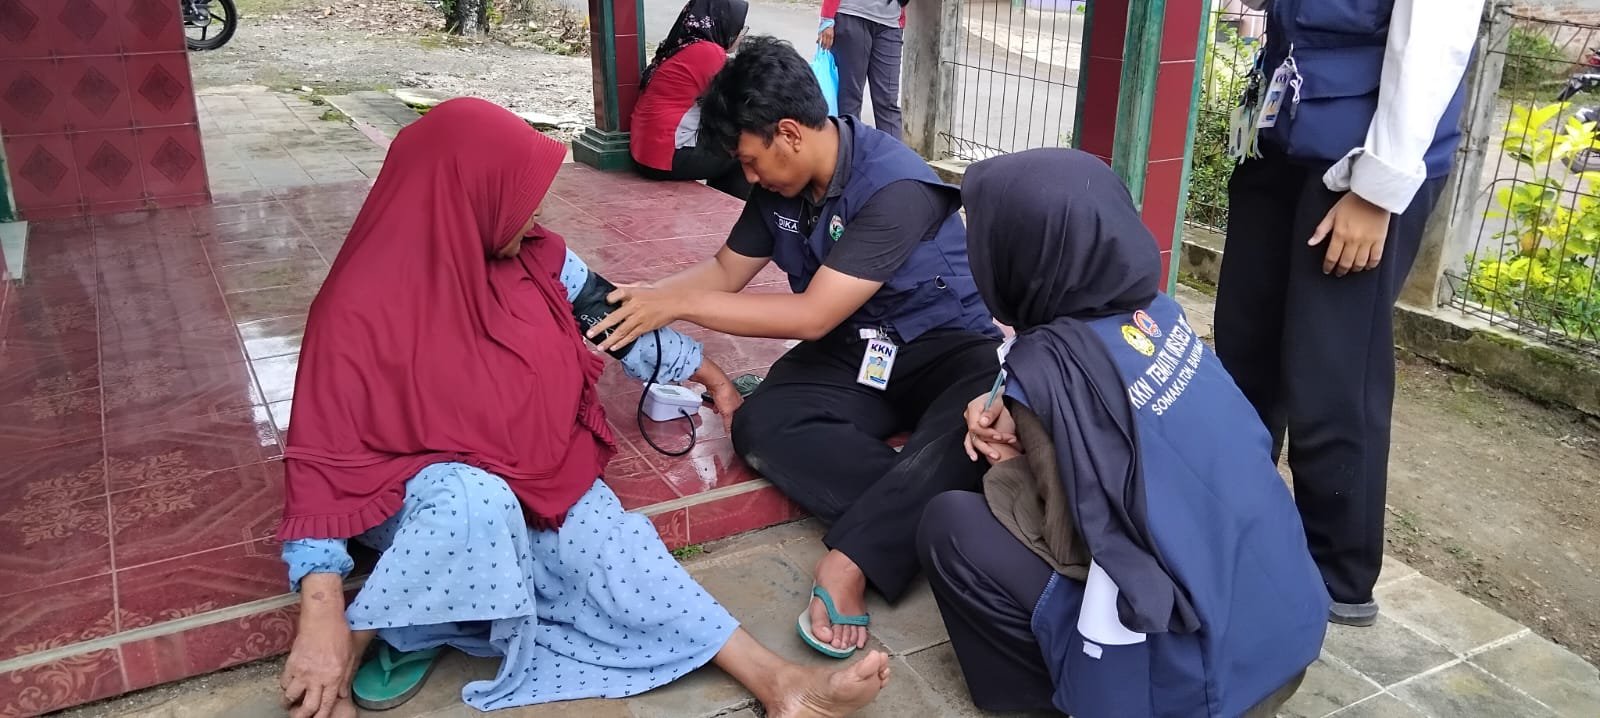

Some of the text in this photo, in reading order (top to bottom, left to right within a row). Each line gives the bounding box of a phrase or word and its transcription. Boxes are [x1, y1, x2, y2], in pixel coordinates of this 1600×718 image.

[778, 218, 798, 231] DIKA
[871, 343, 893, 357] KKN
[1127, 376, 1156, 410] KKN
